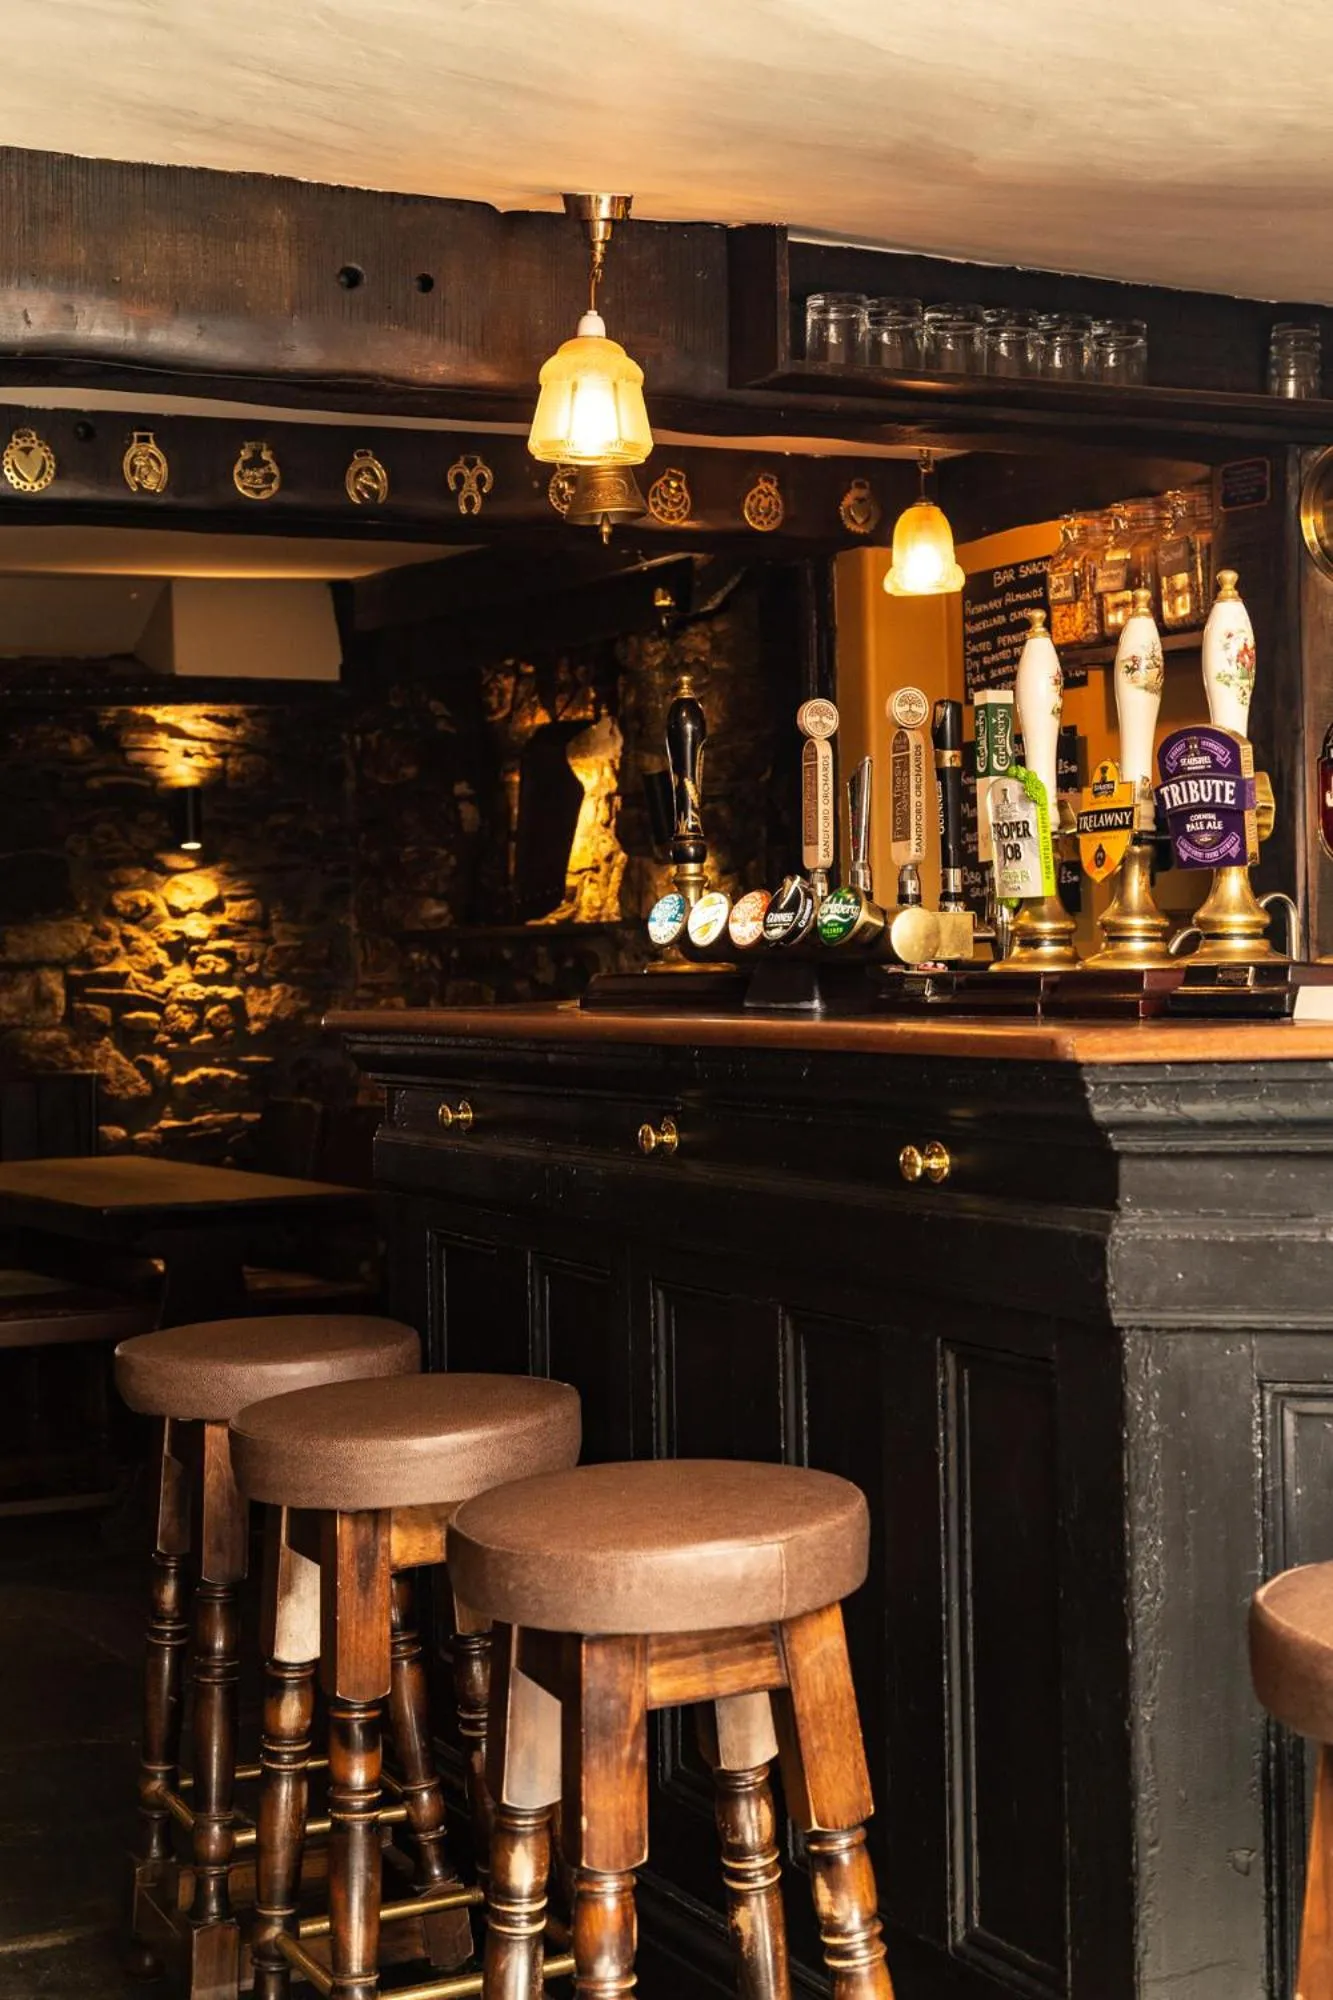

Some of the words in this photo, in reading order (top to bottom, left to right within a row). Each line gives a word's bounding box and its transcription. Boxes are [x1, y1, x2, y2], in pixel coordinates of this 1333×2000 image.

[993, 569, 1016, 588] BAR
[1019, 560, 1051, 578] SNACK
[992, 708, 1010, 771] Carlsberg
[821, 754, 830, 806] ORCHARDS
[914, 744, 922, 798] ORCHARDS
[1159, 779, 1236, 810] TRIBUTE
[822, 809, 831, 859] SANDFORD
[914, 801, 922, 853] SANDFORD
[992, 820, 1032, 839] PROPER
[1079, 811, 1132, 832] TRELAWNY
[1186, 822, 1206, 832] PALE
[1206, 820, 1224, 830] ALE
[1002, 843, 1022, 866] JOB
